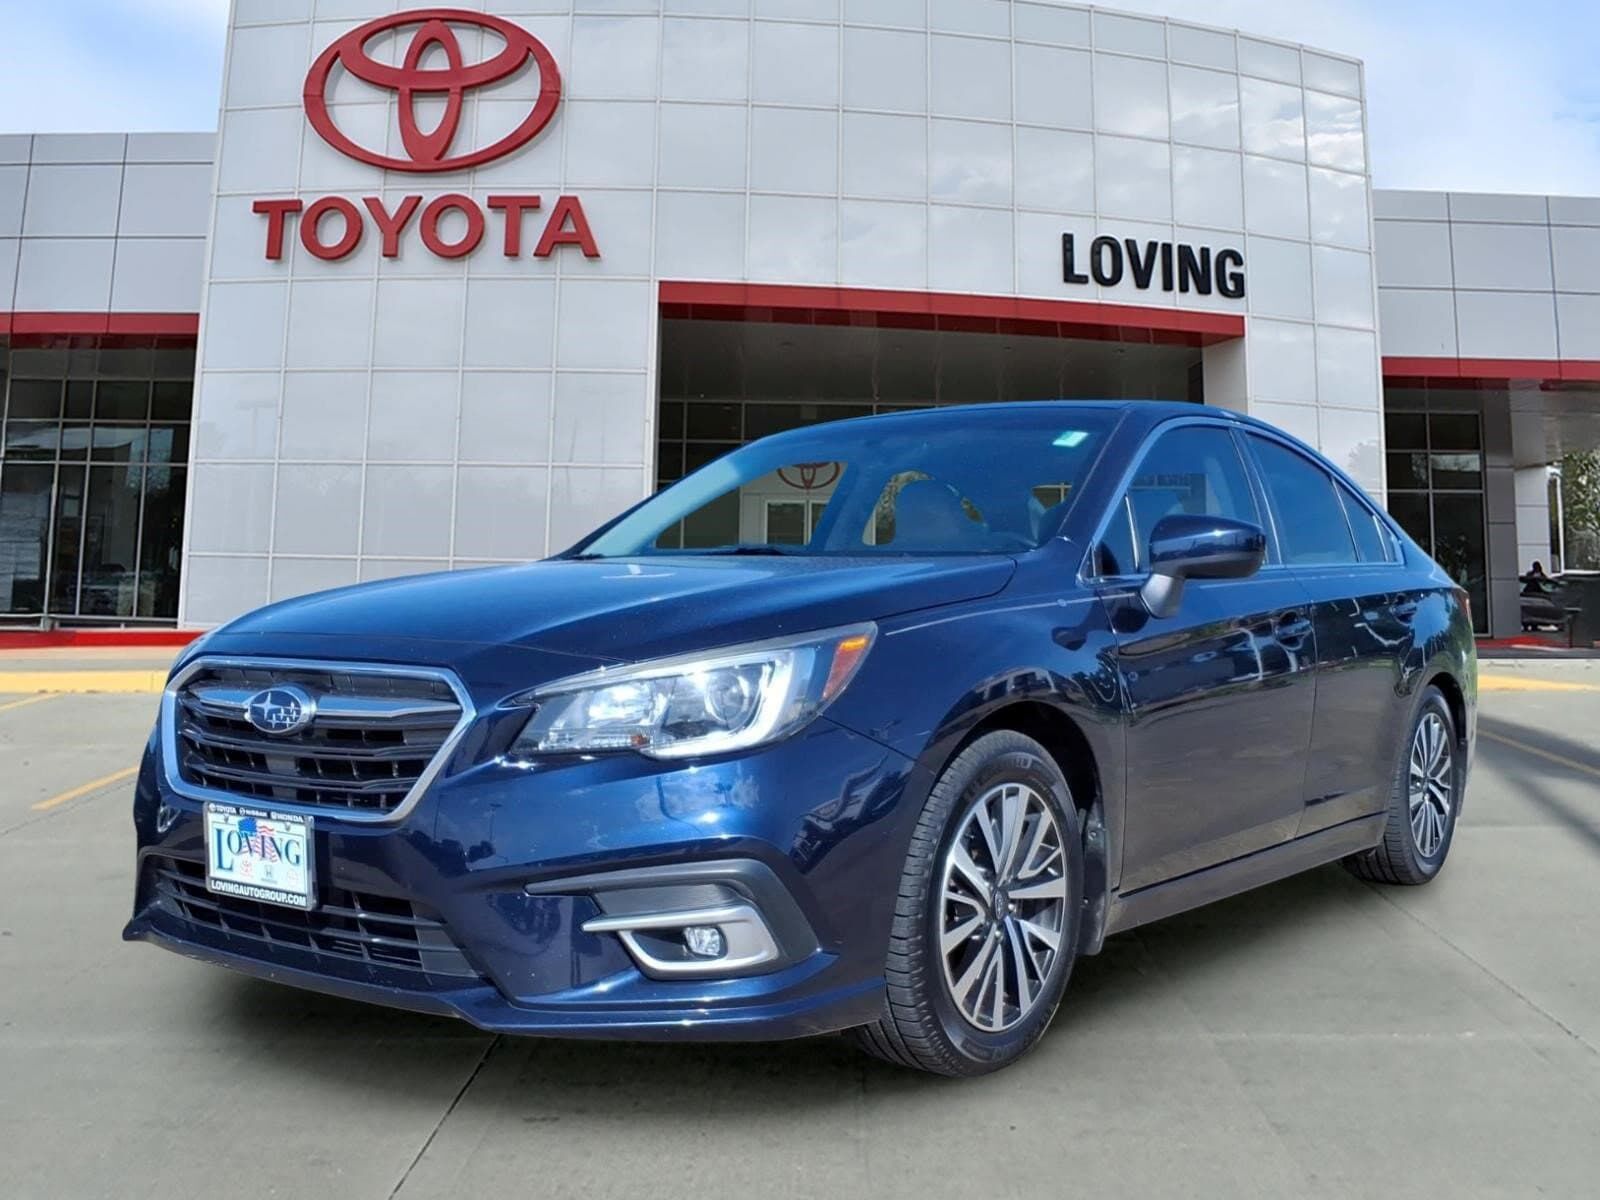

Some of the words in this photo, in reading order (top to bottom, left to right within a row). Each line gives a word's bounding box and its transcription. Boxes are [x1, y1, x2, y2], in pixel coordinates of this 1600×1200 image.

[252, 194, 600, 260] TOYOTA
[1062, 233, 1245, 298] LOVING
[216, 805, 236, 815] TOYOTA
[246, 809, 268, 817] NISSAN
[278, 814, 304, 822] HONDA
[215, 828, 300, 872] LOVING
[211, 880, 306, 906] LOVINGAUTOGROUP.COM
